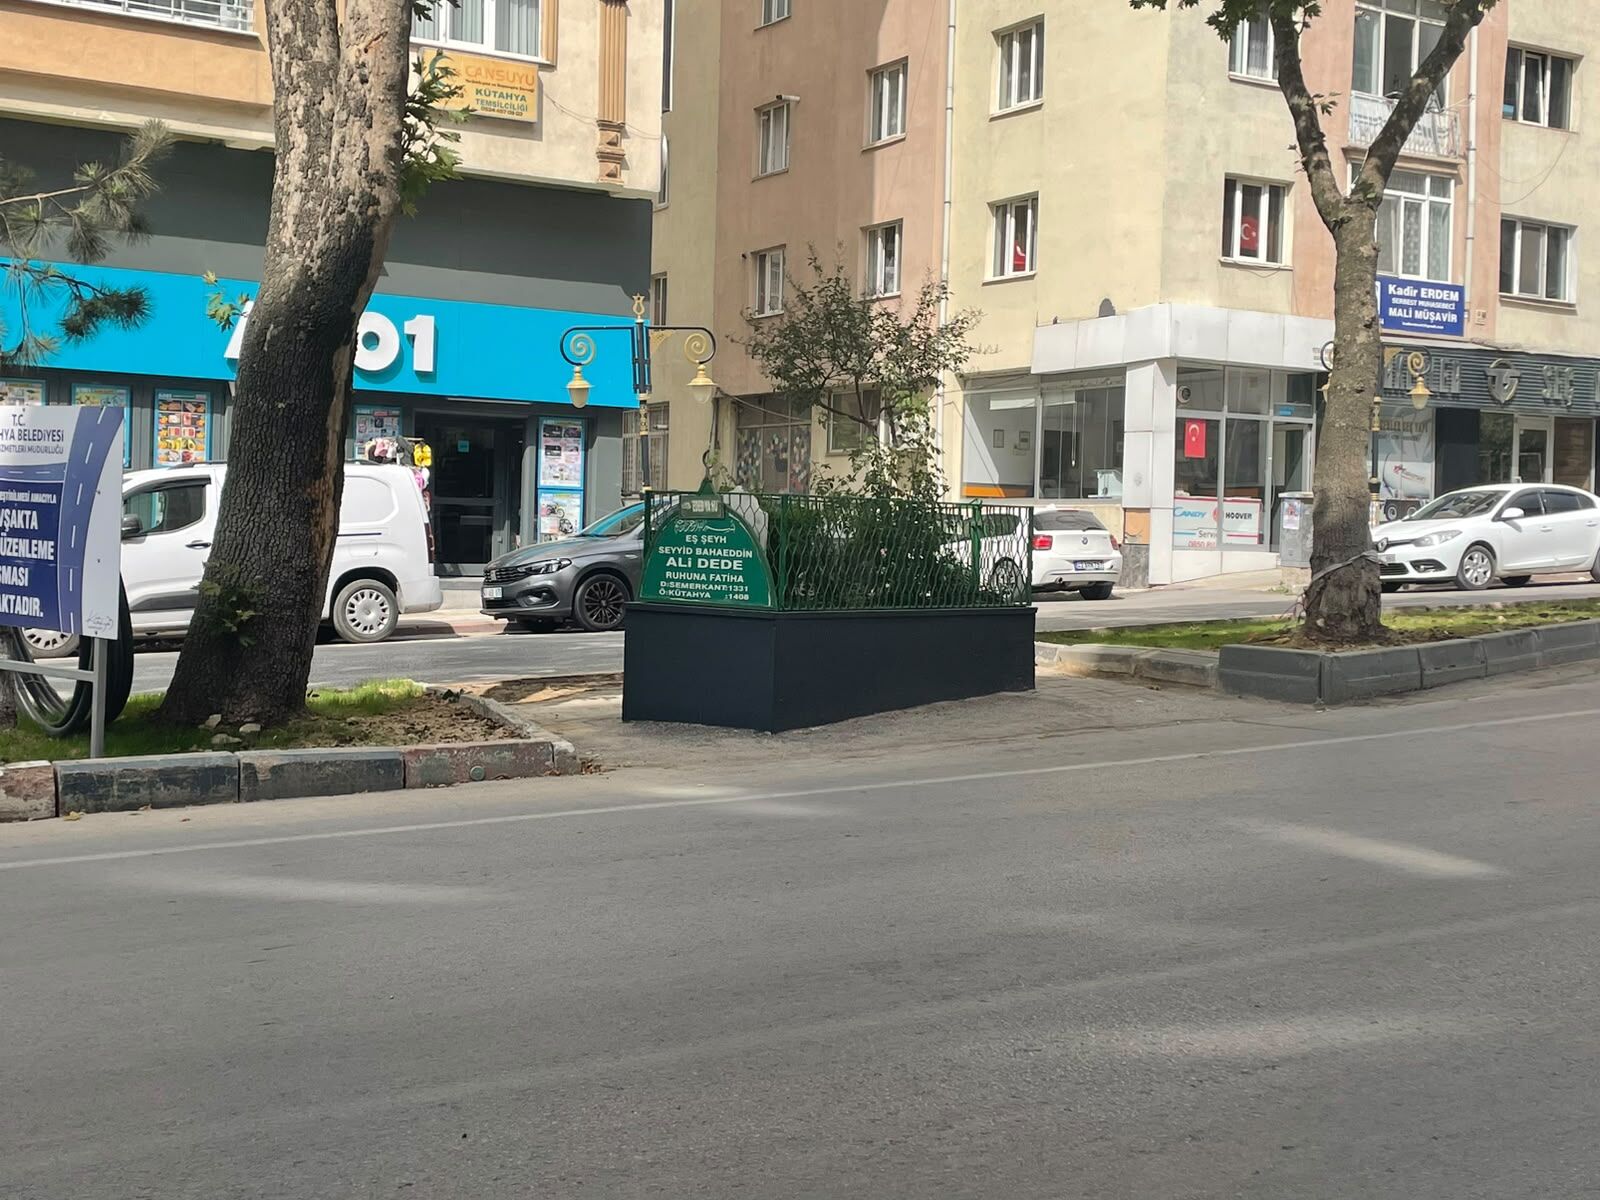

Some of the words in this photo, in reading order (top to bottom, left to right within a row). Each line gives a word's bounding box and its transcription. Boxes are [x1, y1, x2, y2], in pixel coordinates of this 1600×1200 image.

[465, 65, 535, 86] CANSUYU
[475, 88, 527, 102] KÜTAHYA
[1388, 284, 1418, 297] Kadir
[1421, 287, 1459, 302] ERDEM
[1388, 307, 1412, 318] MALİ
[1414, 309, 1458, 323] MÜŞAVİR
[12, 414, 26, 426] T.C.
[1174, 507, 1207, 518] CANDY
[1225, 512, 1252, 520] HOOVER
[0, 532, 55, 560] ÜZENLEME
[685, 534, 698, 544] EŞ
[700, 535, 727, 545] ŞEYH
[658, 546, 693, 555] SEYYİD
[695, 547, 753, 558] BAHAEDDİN
[666, 557, 692, 568] ALİ
[697, 558, 743, 570] DEDE
[665, 571, 707, 581] RUHUNA
[709, 573, 744, 582] FATİHA
